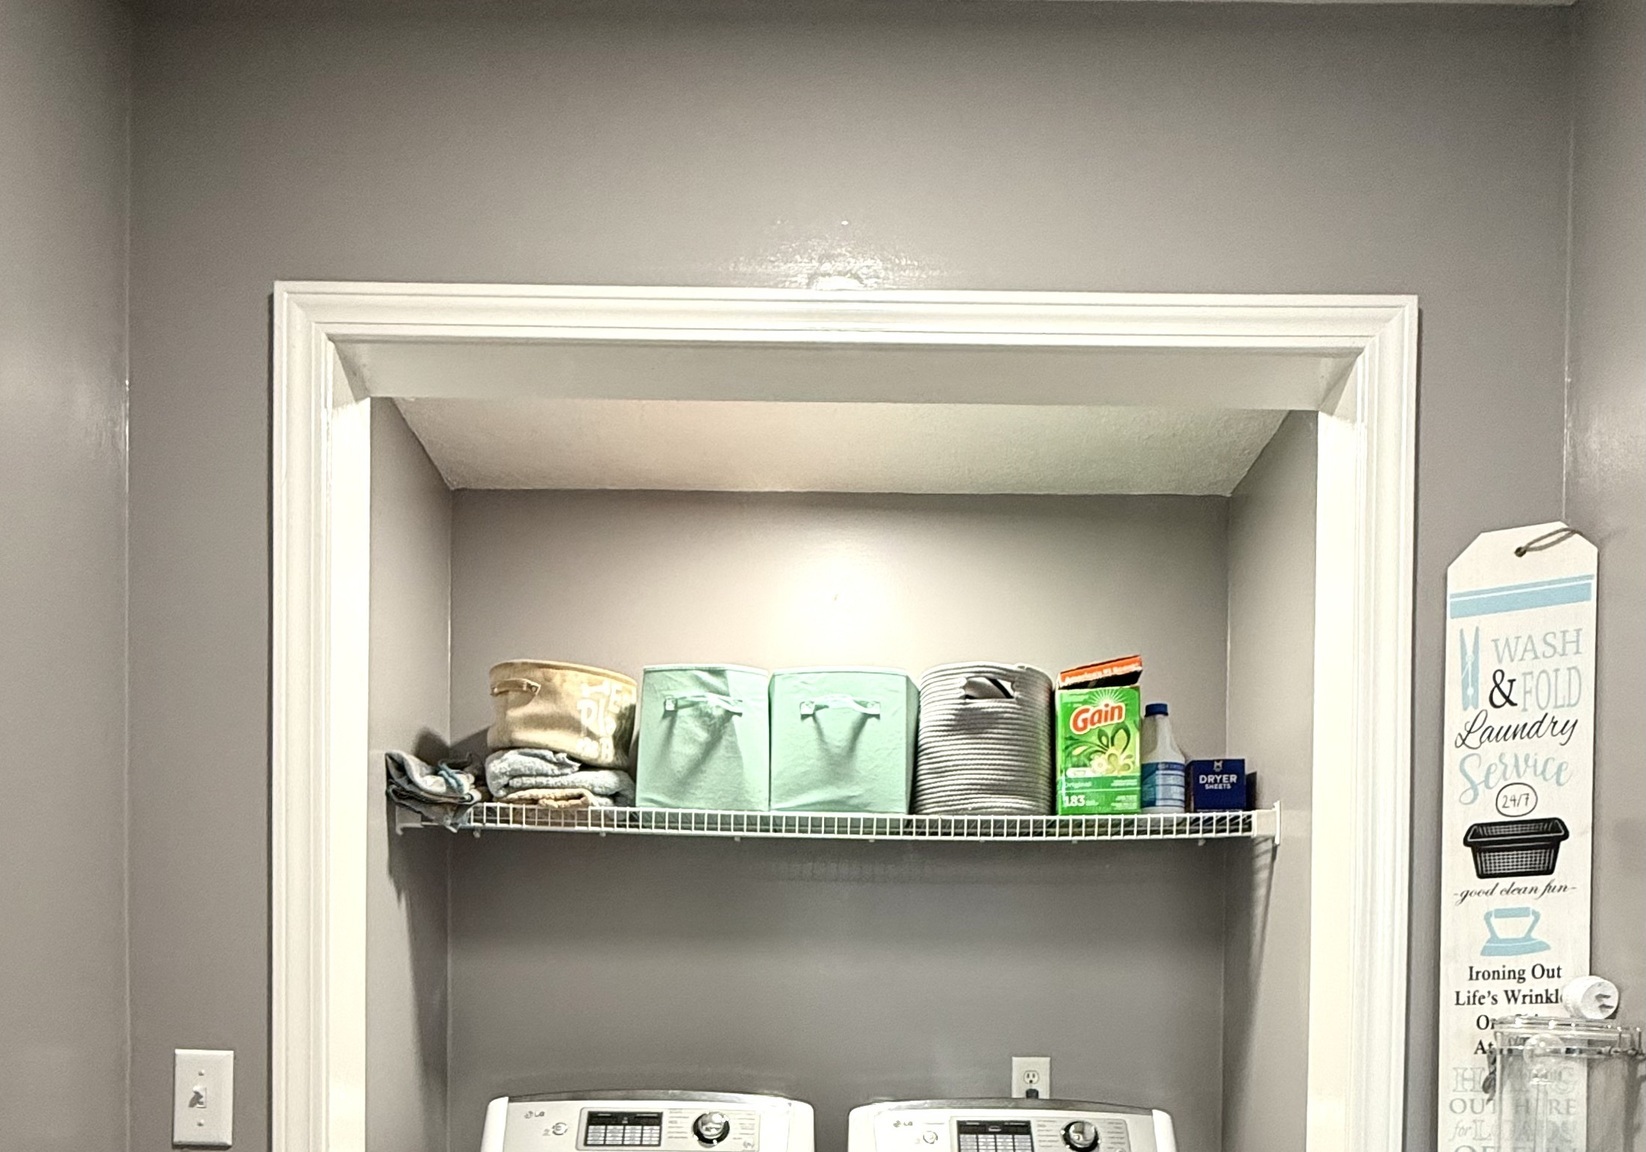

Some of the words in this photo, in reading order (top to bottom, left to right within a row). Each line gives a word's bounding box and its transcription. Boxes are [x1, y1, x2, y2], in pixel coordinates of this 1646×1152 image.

[1491, 628, 1583, 664] WASH
[1488, 669, 1518, 709] &
[1521, 666, 1582, 712] FOLD
[1071, 703, 1125, 733] Gain
[1454, 709, 1579, 750] Laundry
[1199, 774, 1238, 784] DRYER
[1458, 752, 1571, 806] Service
[1502, 793, 1530, 809] 24/7
[1500, 881, 1539, 896] clean
[1468, 964, 1526, 984] Ironing
[1531, 963, 1562, 979] Out
[1454, 990, 1498, 1006] Life's
[1504, 988, 1563, 1005] Wrinkl
